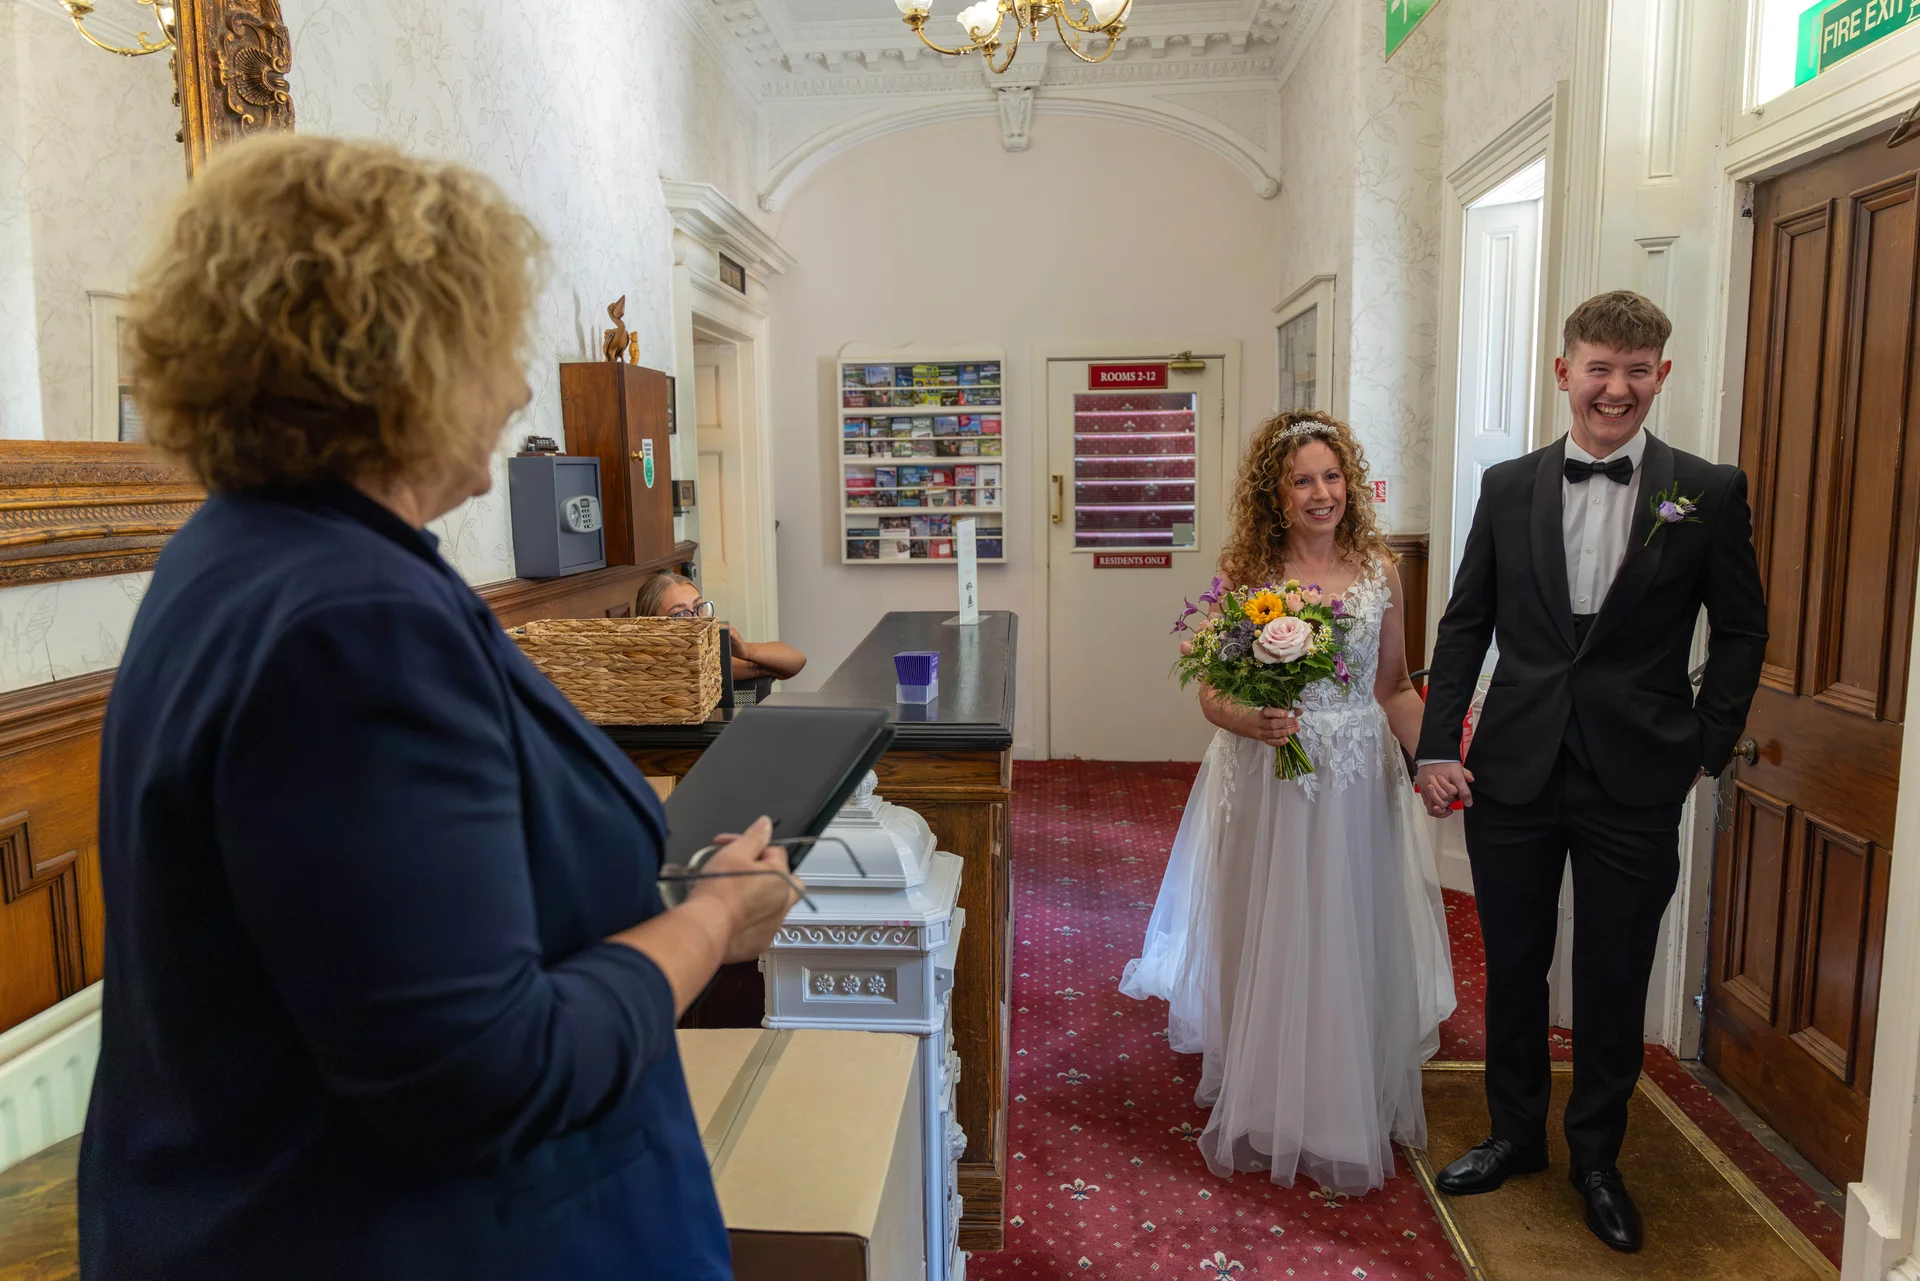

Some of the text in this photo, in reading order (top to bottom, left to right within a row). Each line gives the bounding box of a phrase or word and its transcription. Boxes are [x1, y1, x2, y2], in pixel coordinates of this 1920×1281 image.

[1823, 8, 1862, 54] FIRE
[1100, 371, 1156, 382] ROOMS 2-12
[1099, 557, 1167, 565] RESIDENTS ONLY
